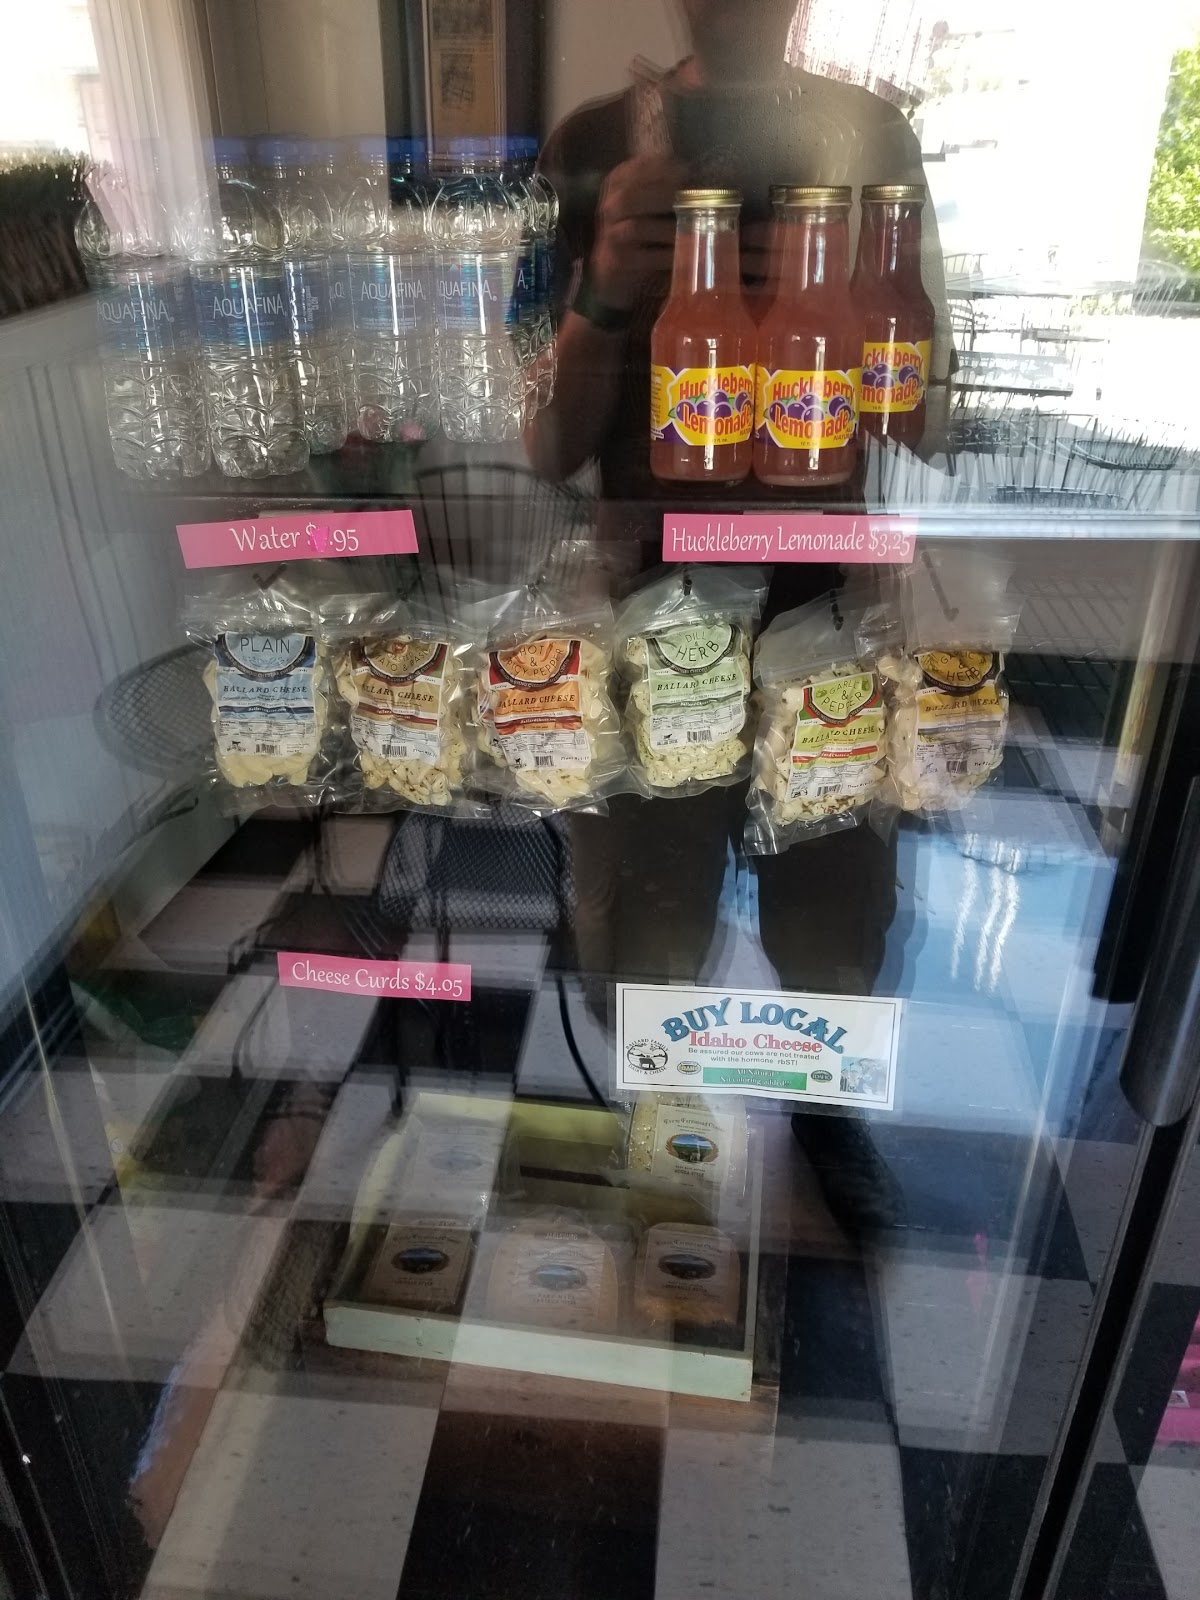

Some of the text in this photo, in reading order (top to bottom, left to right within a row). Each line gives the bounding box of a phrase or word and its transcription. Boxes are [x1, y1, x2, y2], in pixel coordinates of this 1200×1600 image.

[361, 279, 423, 301] AQUAFINA
[438, 279, 493, 300] QUAFINA
[213, 293, 284, 319] AQUAFINA
[865, 347, 923, 374] ckleberry
[679, 372, 753, 401] Huckleberr
[773, 377, 854, 405] Huckleberry
[862, 377, 918, 404] monade
[775, 405, 849, 439] Lemonade
[229, 522, 359, 552] Water $.95
[671, 521, 911, 560] Huckleberry Lemonade $3.25
[240, 637, 290, 654] PLAIN
[519, 645, 544, 656] HOT
[675, 640, 720, 662] HERB
[530, 657, 538, 667] &
[533, 648, 564, 676] PEPPER
[702, 673, 737, 685] CHEESE
[946, 667, 980, 681] HERB
[223, 685, 270, 694] BALLARD
[539, 694, 575, 704] CHEESE
[292, 960, 350, 985] Cheese
[354, 968, 410, 990] Curds
[661, 997, 847, 1054] BUY LOCAL
[689, 1031, 823, 1053] Idaho Cheese
[700, 1047, 729, 1055] assured
